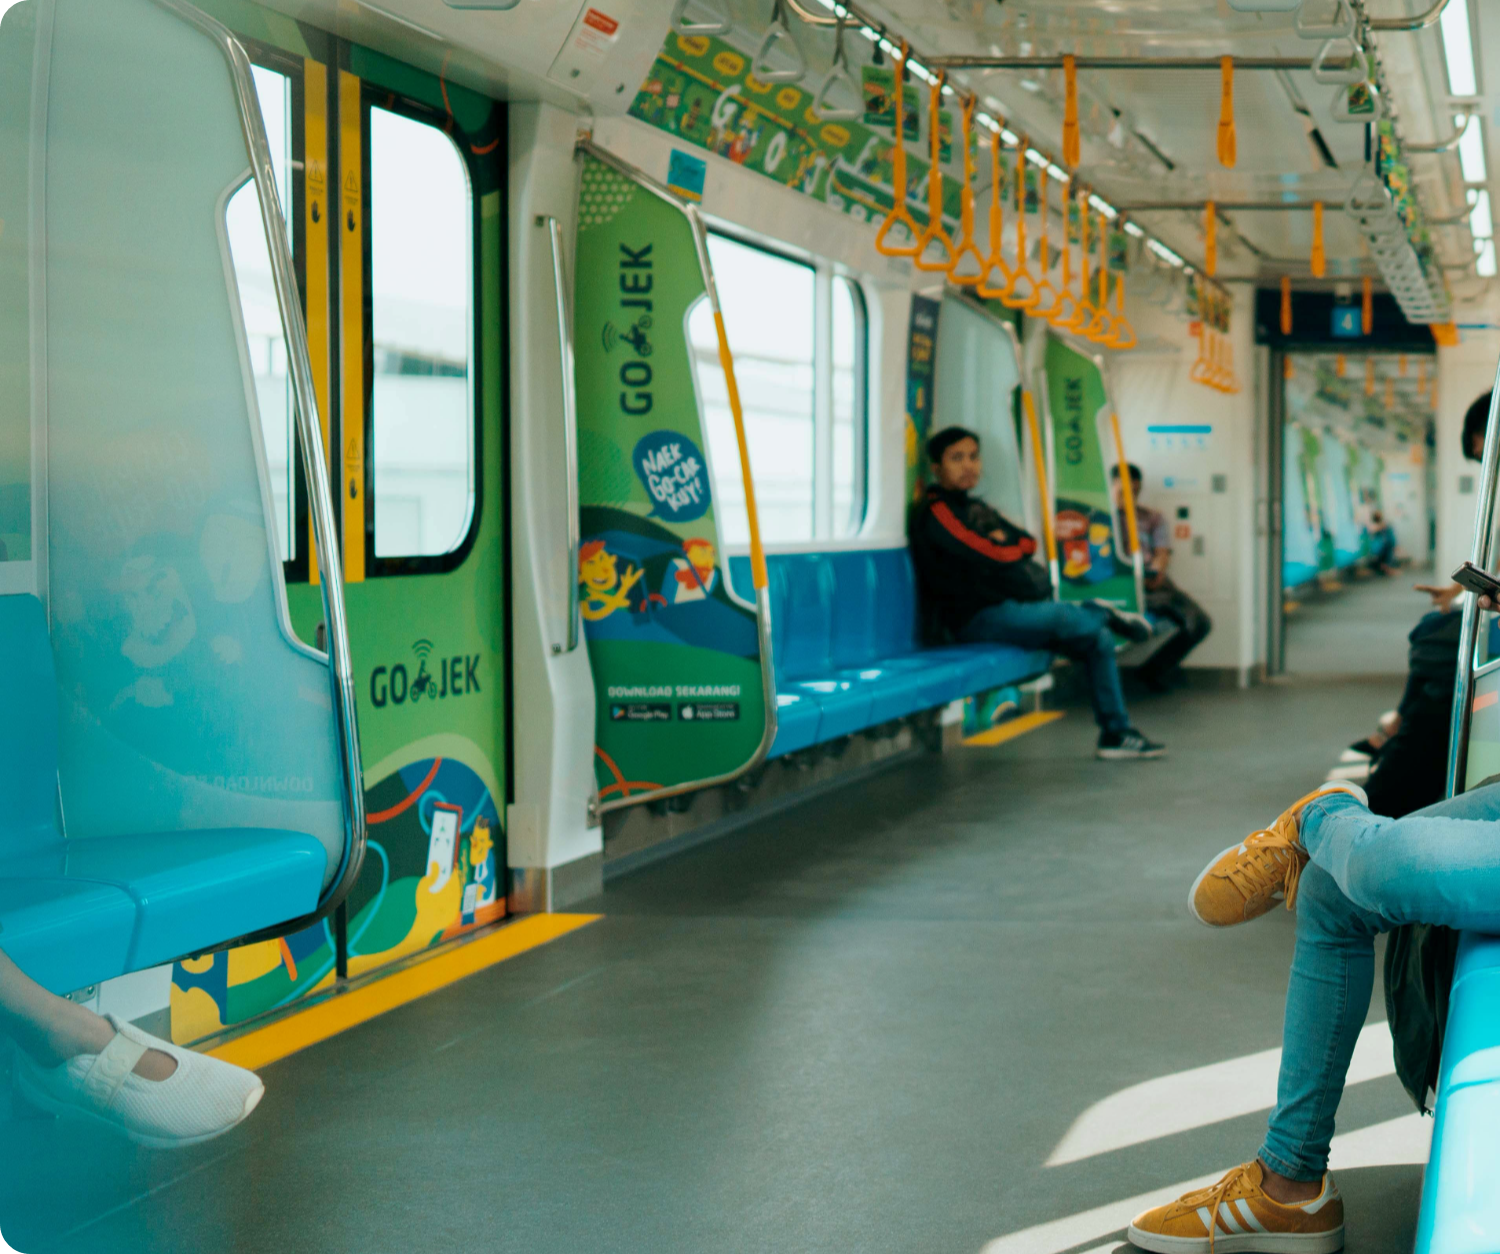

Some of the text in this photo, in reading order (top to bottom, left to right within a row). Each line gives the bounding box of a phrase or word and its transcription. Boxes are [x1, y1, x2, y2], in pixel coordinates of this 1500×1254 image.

[642, 443, 683, 476] NAEK
[648, 456, 702, 502] GO-CAR
[666, 477, 703, 513] KUY!
[607, 685, 741, 698] DOWNLOAD SEKARANG!
